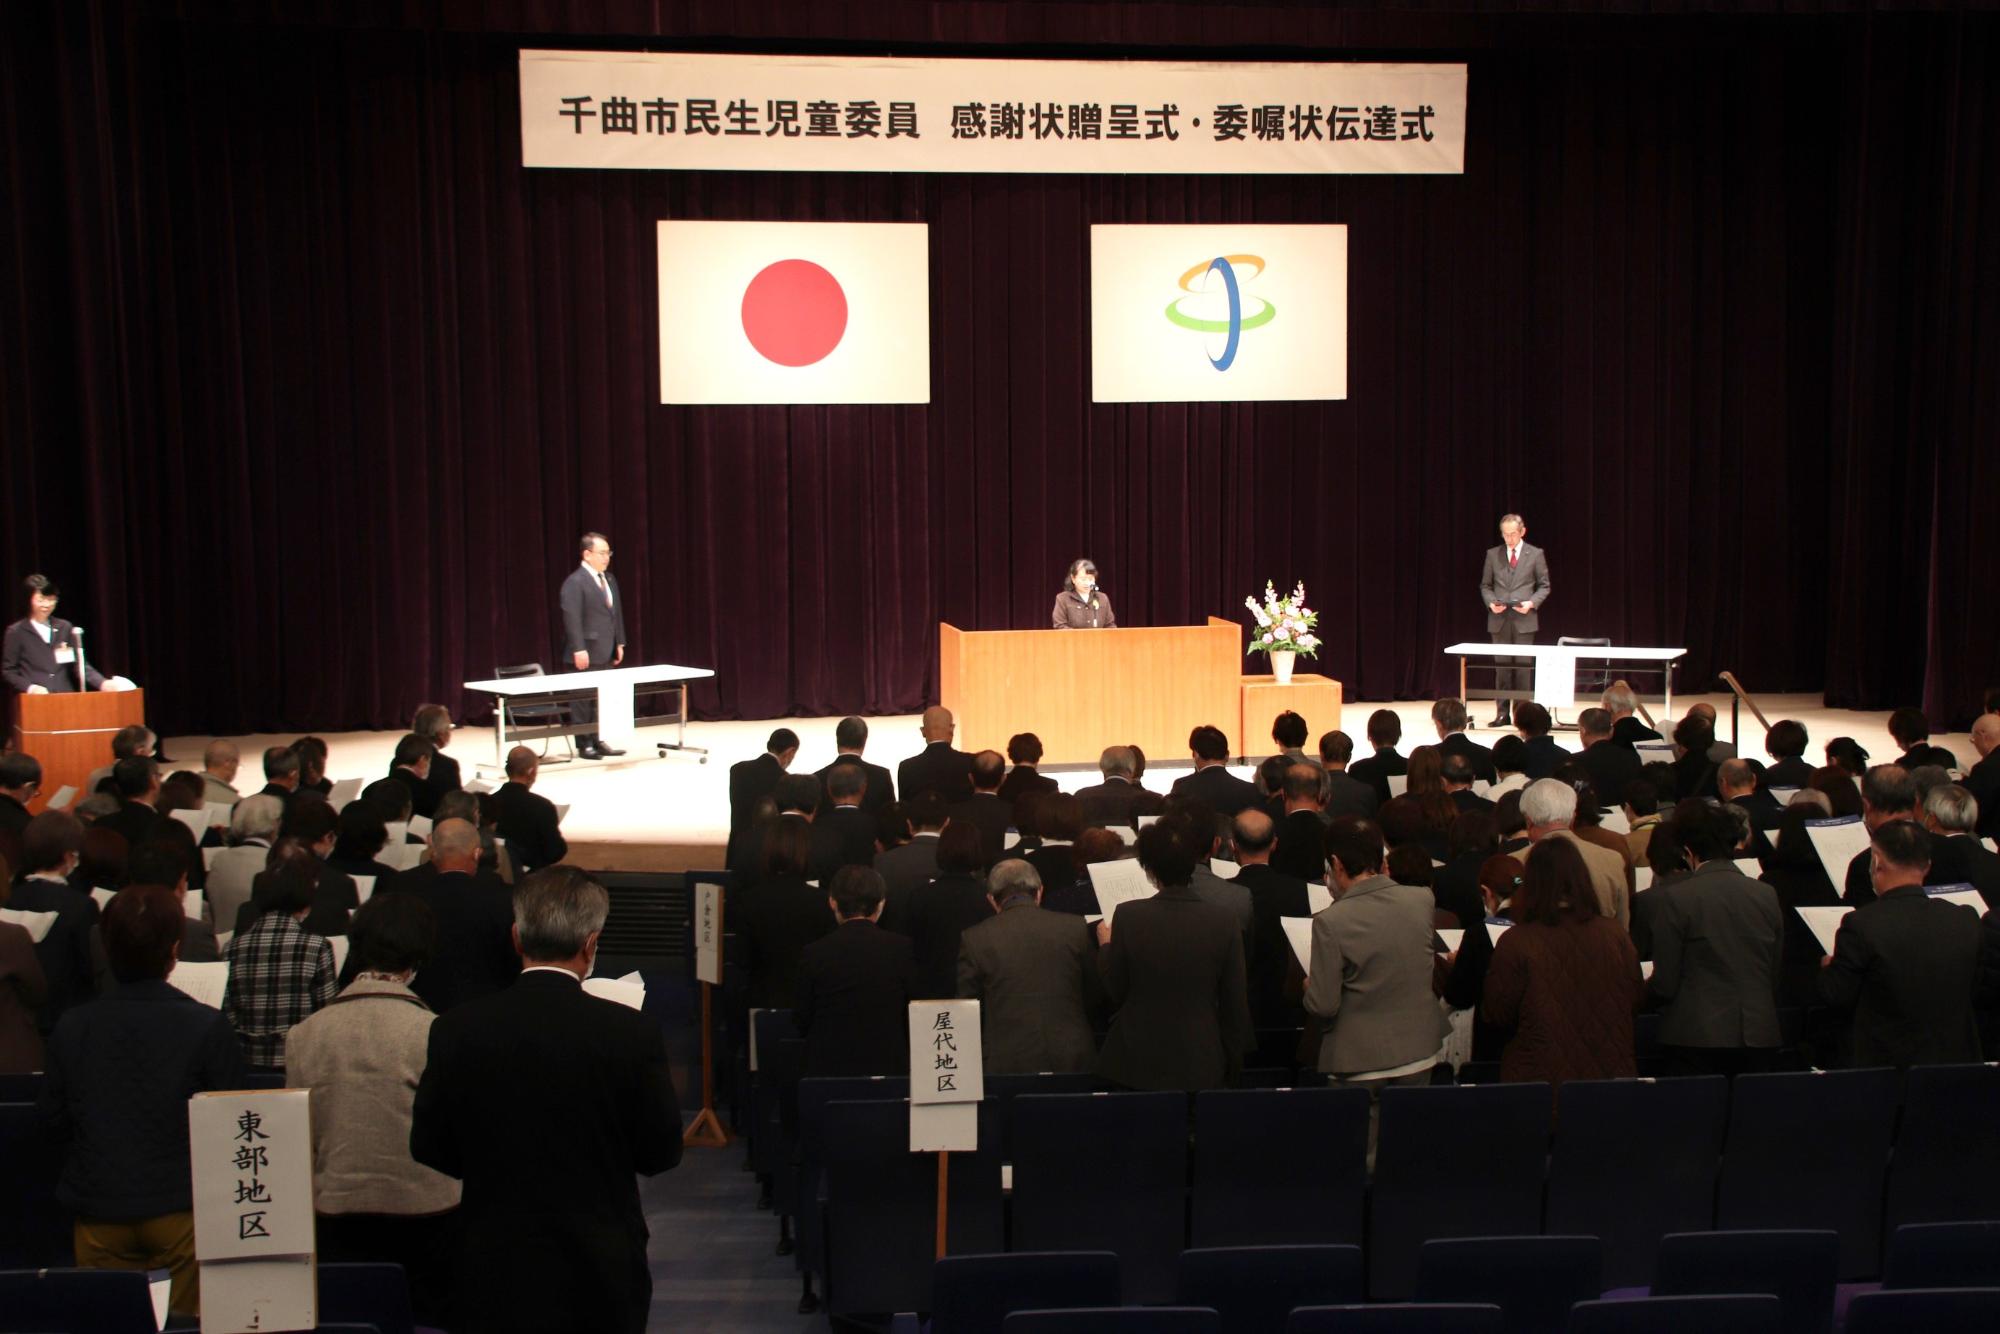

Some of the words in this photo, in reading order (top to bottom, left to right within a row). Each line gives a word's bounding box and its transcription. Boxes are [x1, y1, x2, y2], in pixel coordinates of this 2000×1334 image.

[558, 95, 921, 139] 千曲市民生児童委員
[950, 101, 1436, 143] 感謝状贈呈式・委嘱状伝達式
[932, 1011, 958, 1093] 屋代地区
[231, 1109, 273, 1241] 東部地区
